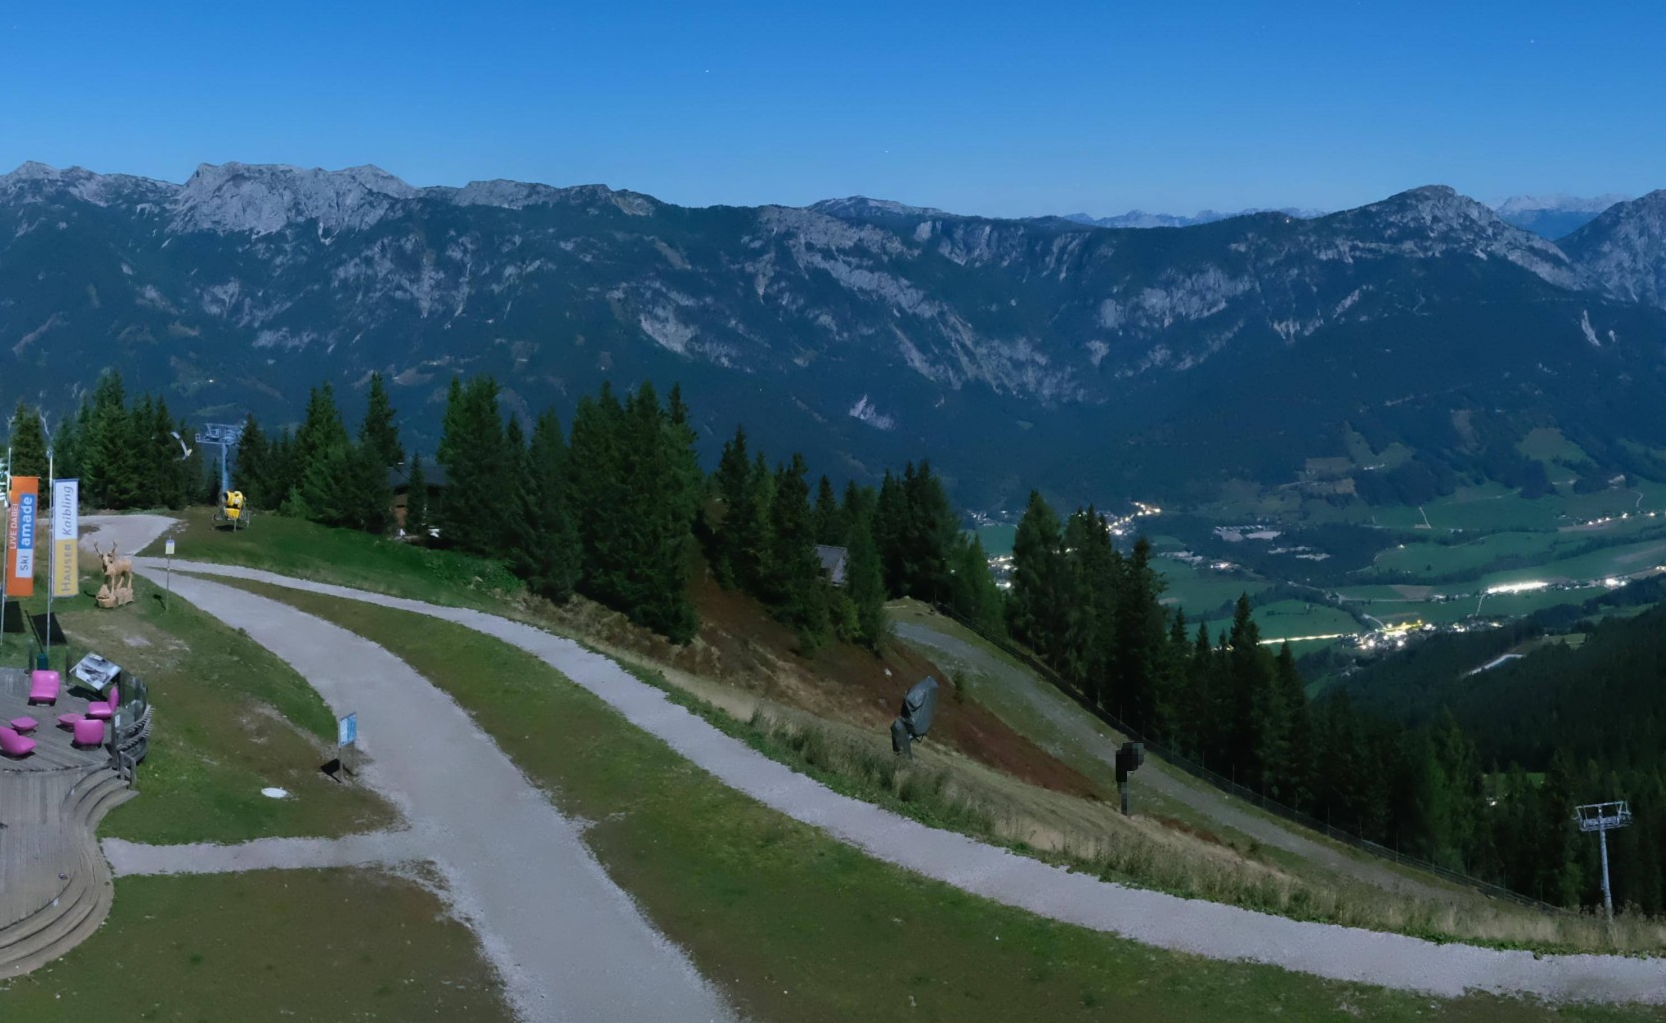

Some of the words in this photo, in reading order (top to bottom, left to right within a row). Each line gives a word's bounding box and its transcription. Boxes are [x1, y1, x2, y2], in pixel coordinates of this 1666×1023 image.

[62, 485, 74, 536] Kaibling
[9, 530, 17, 549] LIVE
[20, 555, 29, 571] Ski
[61, 544, 72, 592] HAUSER
